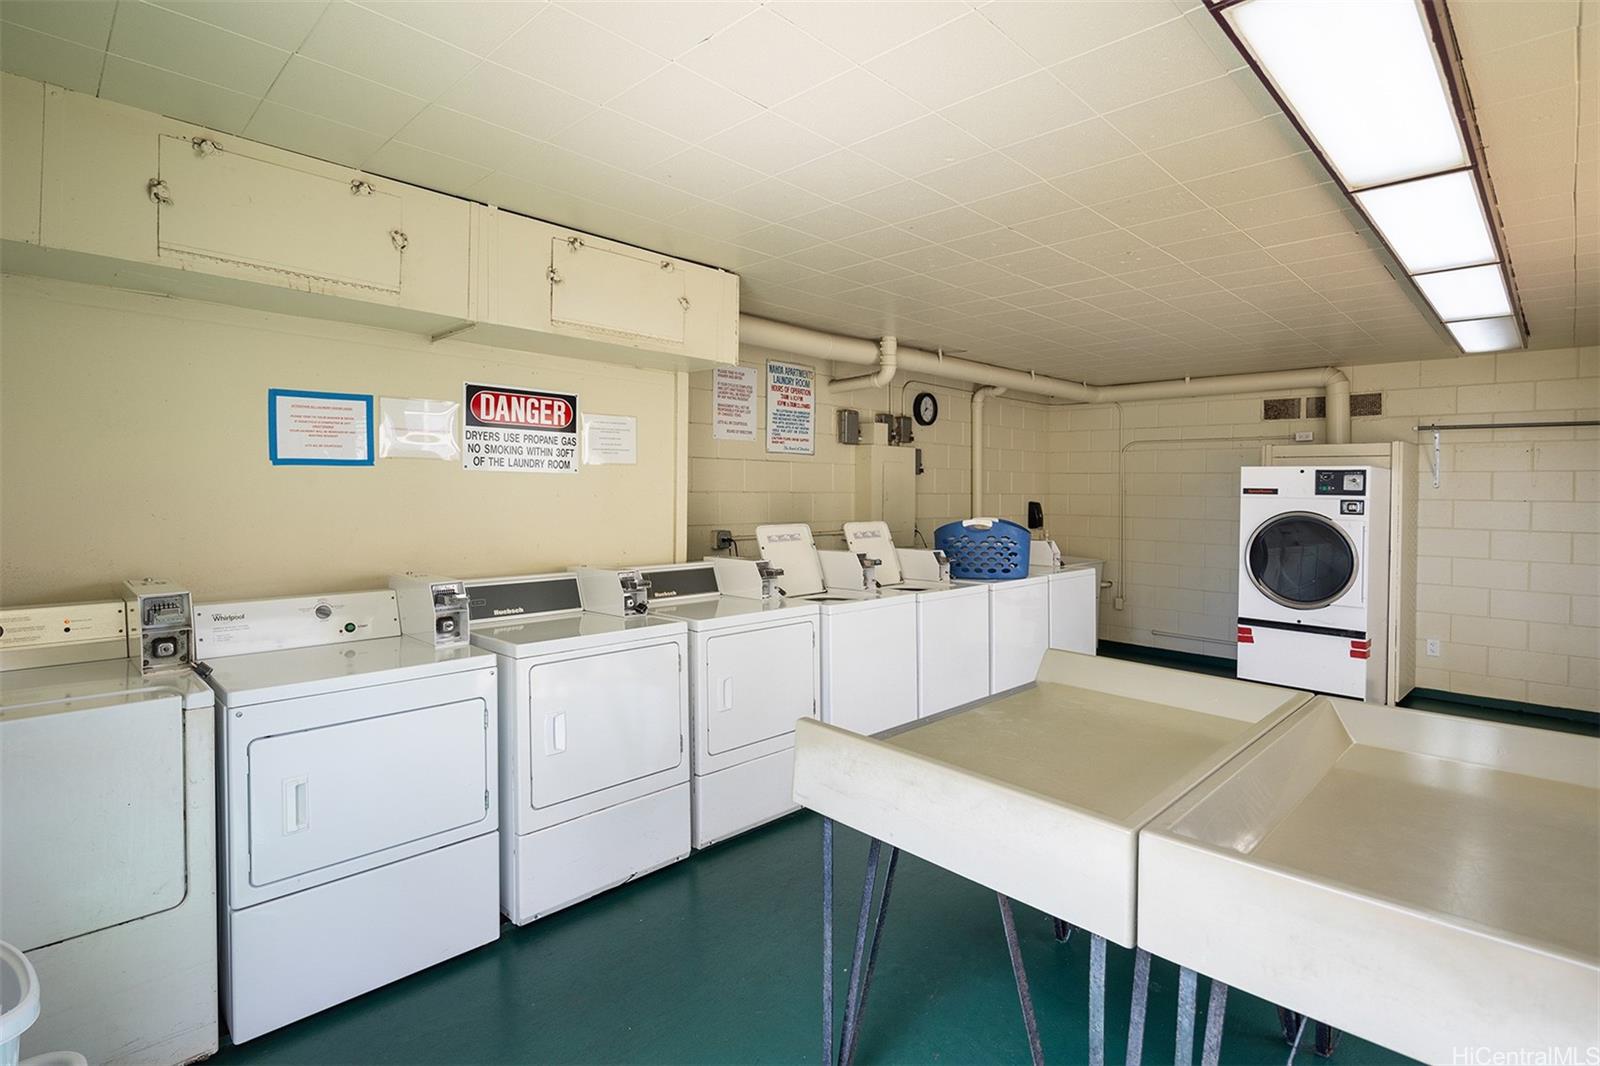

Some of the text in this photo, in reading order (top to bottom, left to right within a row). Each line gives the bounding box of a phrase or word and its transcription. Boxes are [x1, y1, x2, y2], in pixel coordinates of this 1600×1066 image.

[480, 393, 566, 426] DANGER
[465, 430, 577, 447] DRYERS USE PROPANE GAS
[467, 443, 574, 458] NO SMOKING WITHIN 30FT
[473, 456, 570, 469] OF THE LAUNDRY ROOM
[211, 613, 245, 622] Whirlpool
[493, 607, 524, 616] Huebsch
